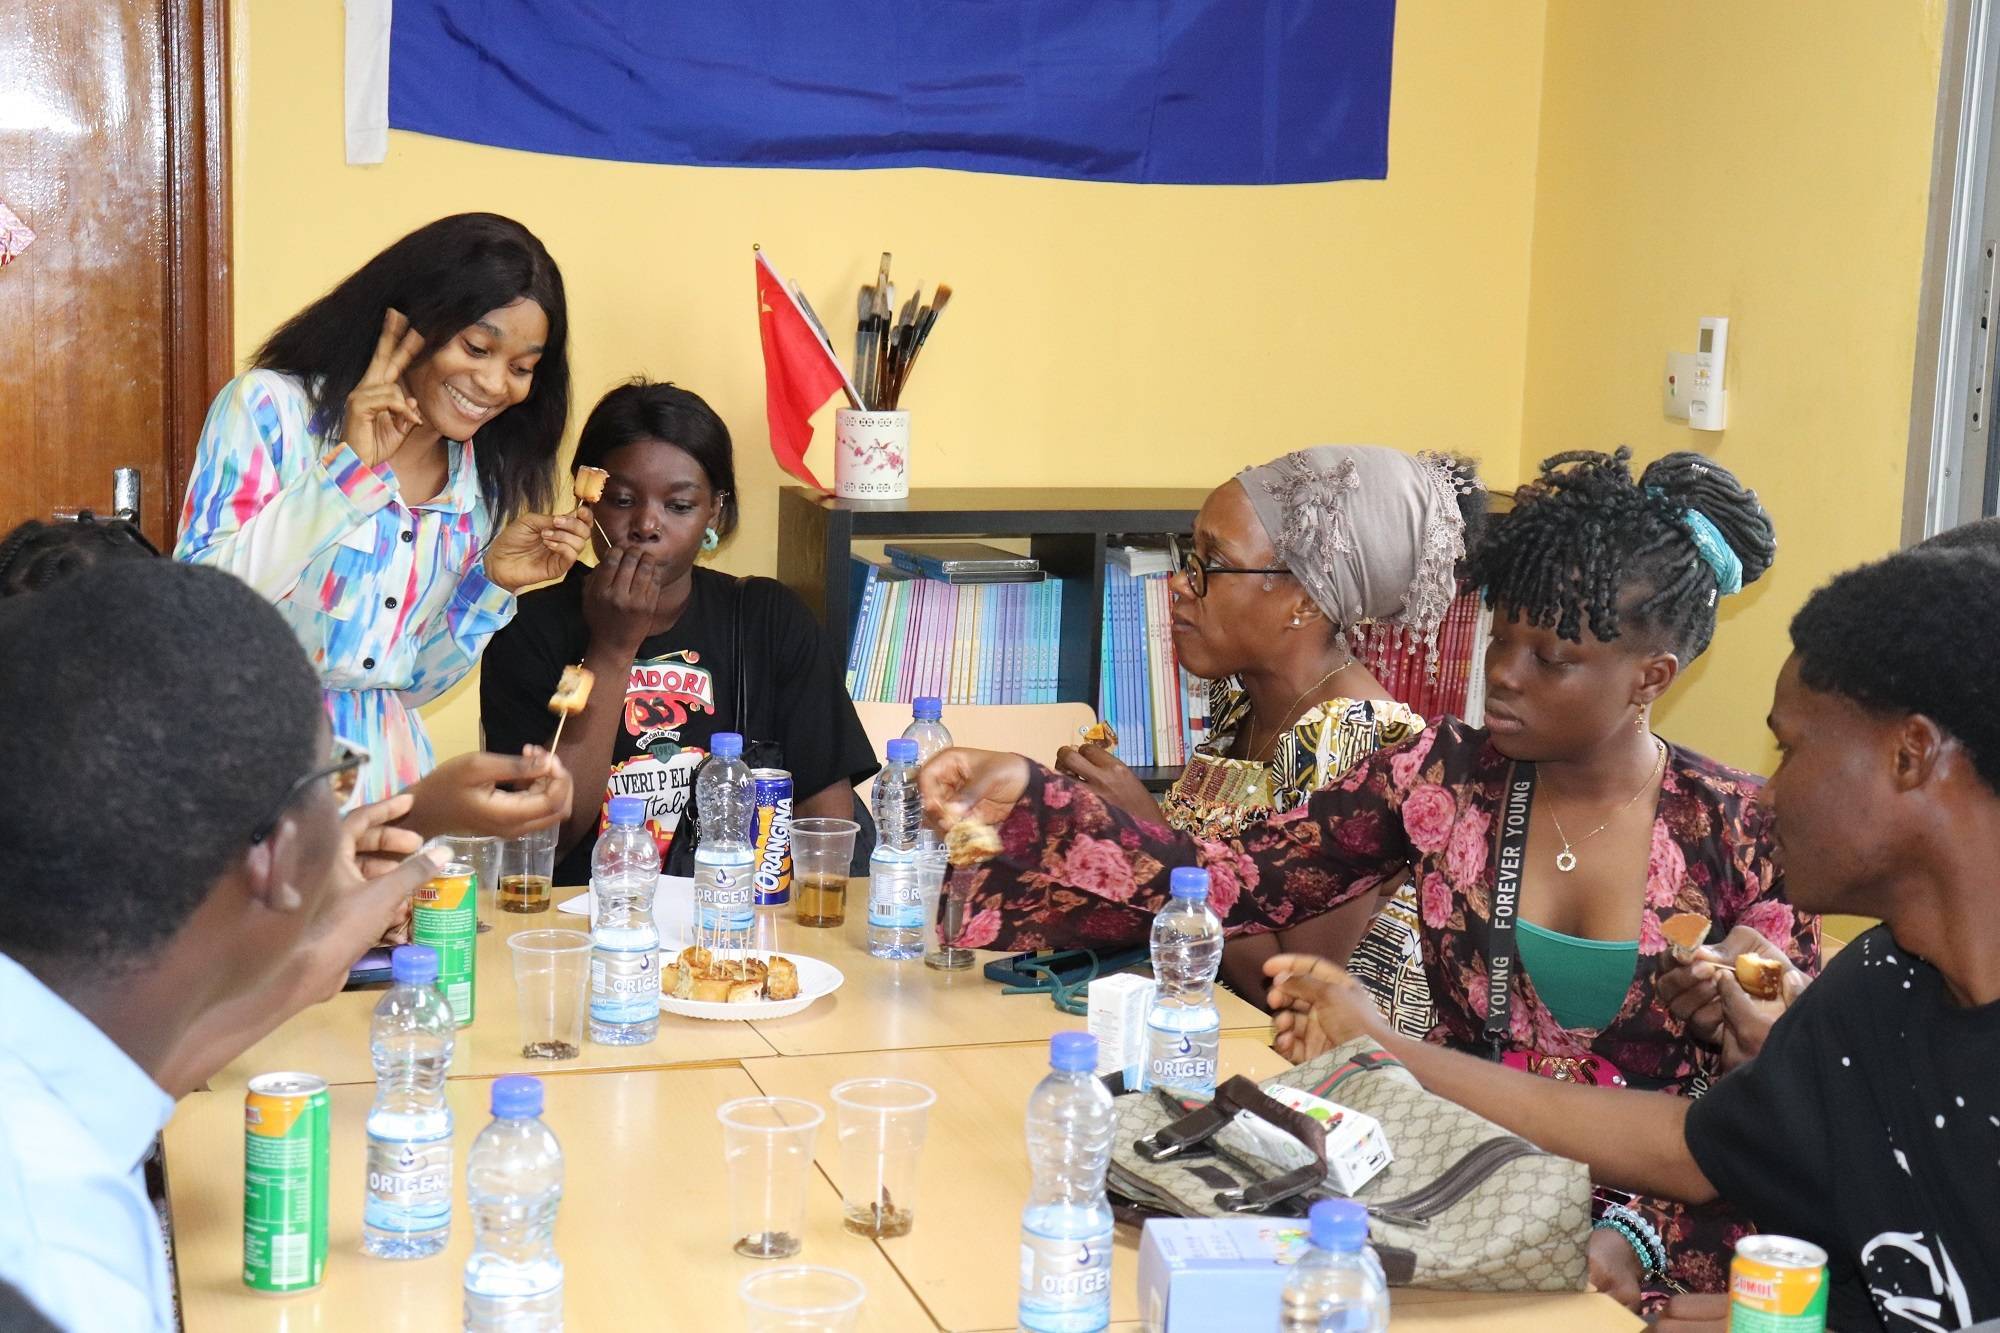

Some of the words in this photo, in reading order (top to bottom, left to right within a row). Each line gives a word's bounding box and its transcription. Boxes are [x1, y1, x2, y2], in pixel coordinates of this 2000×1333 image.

[1505, 780, 1531, 838] YOUNG
[754, 797, 793, 891] ORANGINA
[697, 888, 750, 904] ORIGEN
[1494, 846, 1521, 930] FOREVER
[1489, 956, 1510, 1017] YOUNG
[1153, 1059, 1214, 1078] ORIGEN
[368, 1171, 446, 1195] ORIGEN
